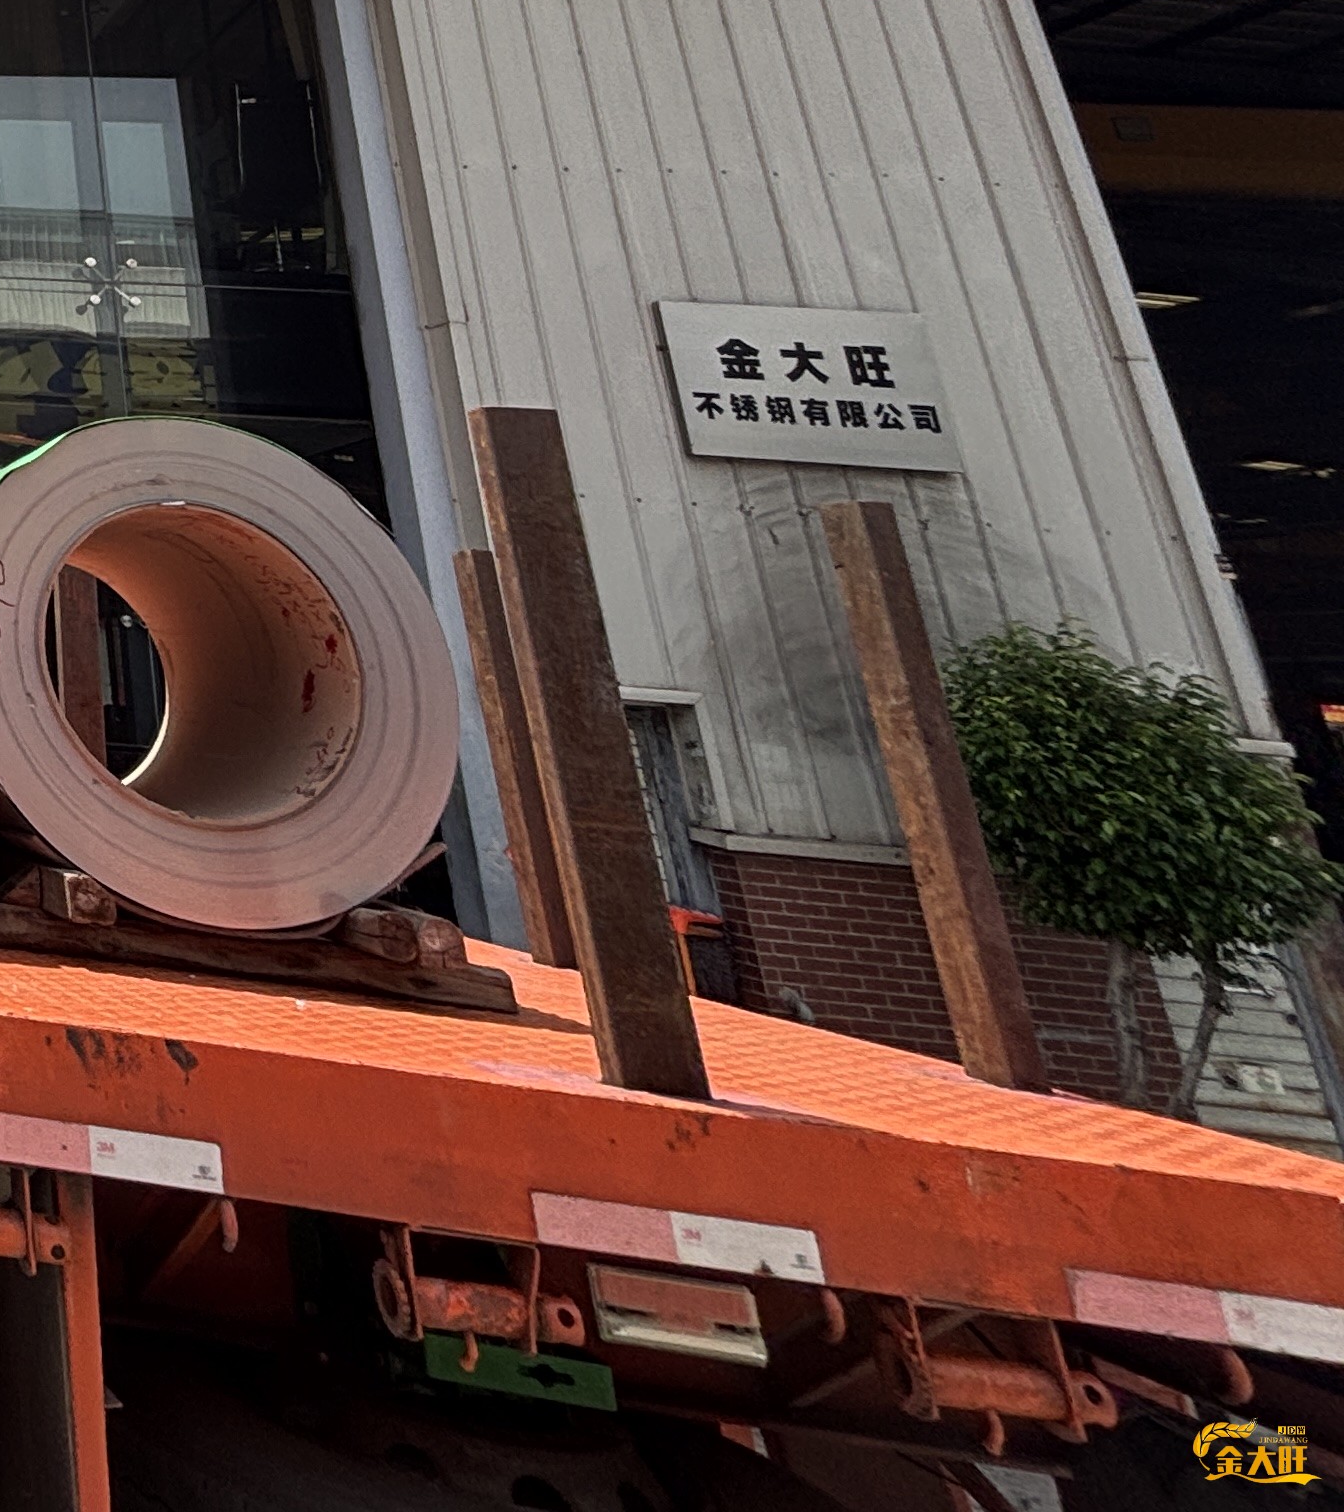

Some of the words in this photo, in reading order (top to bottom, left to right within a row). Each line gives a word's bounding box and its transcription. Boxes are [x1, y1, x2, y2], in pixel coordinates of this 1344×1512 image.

[716, 338, 896, 389] 金大旺
[692, 391, 943, 434] 不锈钢有限公司
